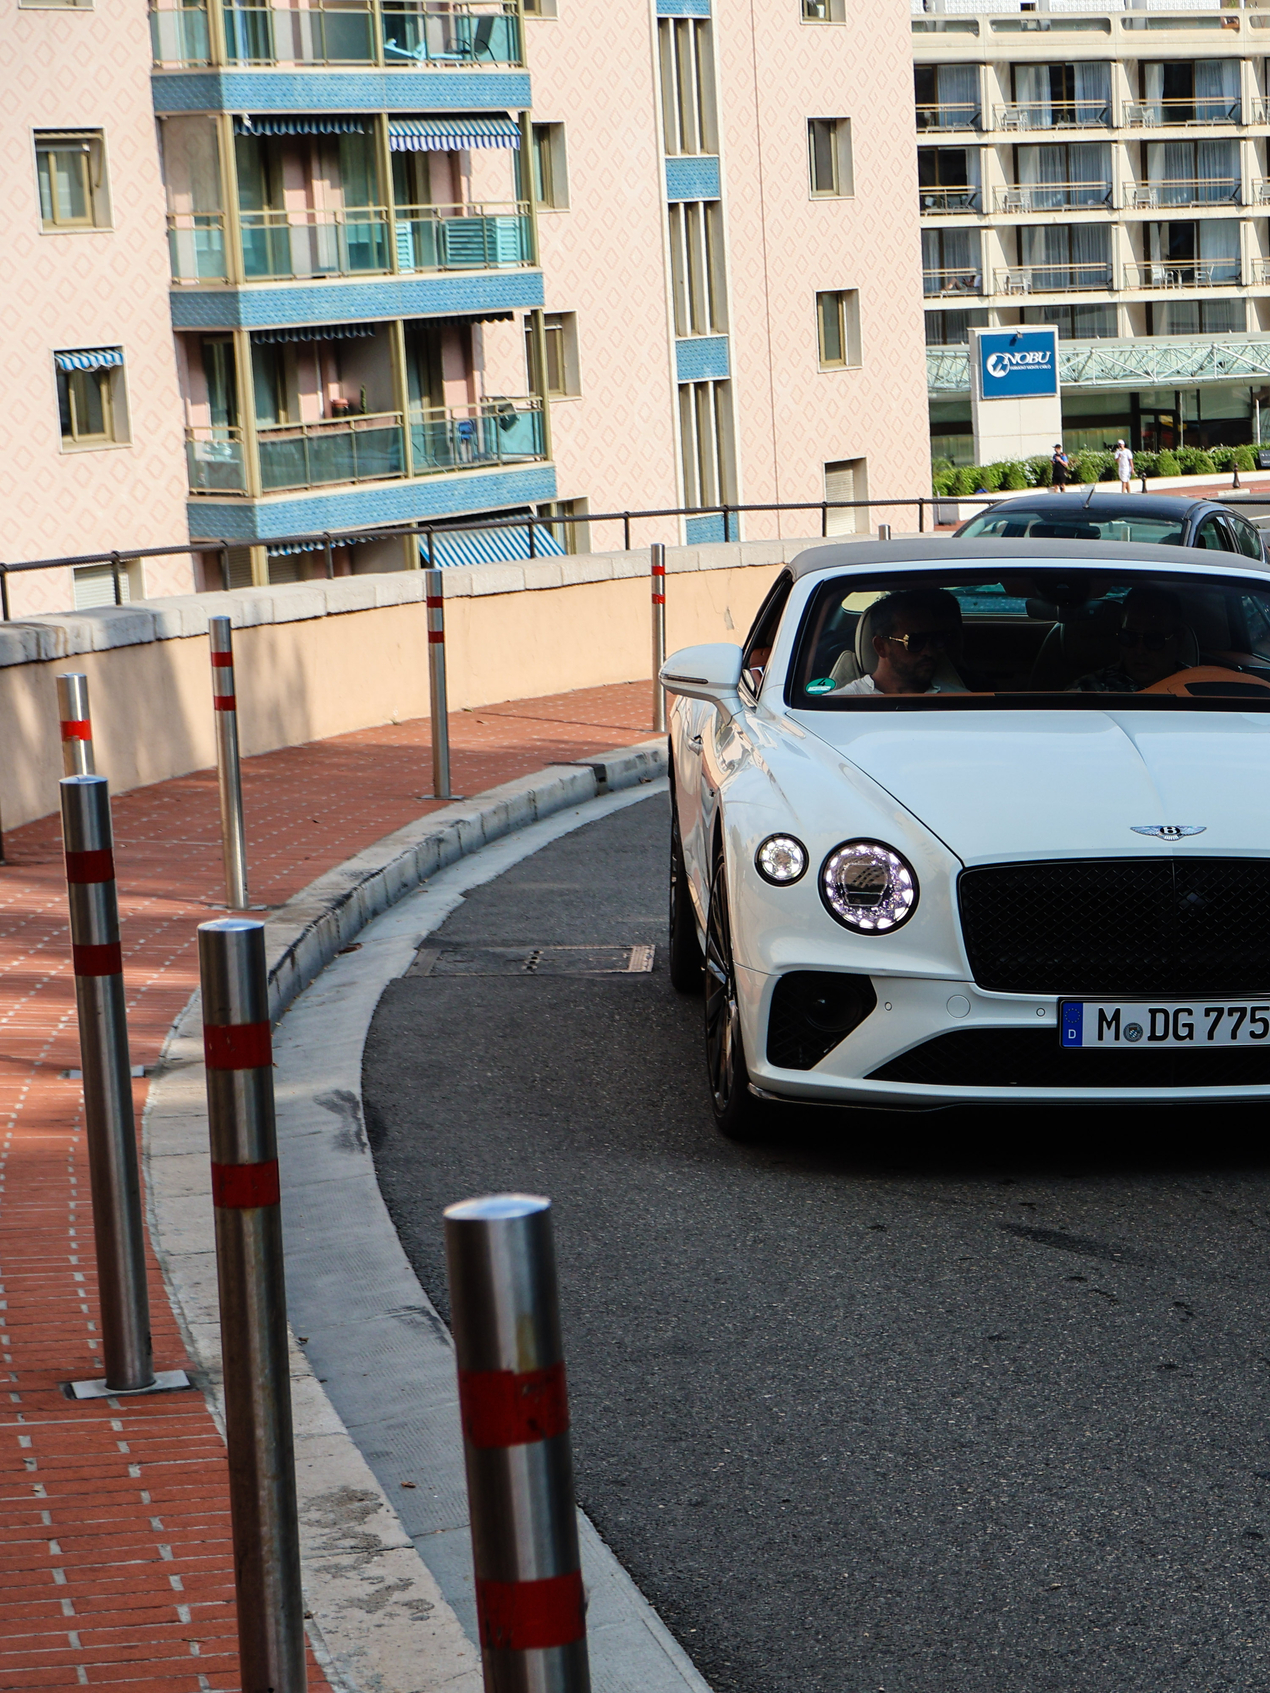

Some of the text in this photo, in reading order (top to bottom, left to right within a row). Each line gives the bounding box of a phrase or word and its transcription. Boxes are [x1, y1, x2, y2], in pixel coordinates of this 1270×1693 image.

[1002, 351, 1052, 365] NOBU
[1098, 1005, 1270, 1042] M DG 775
[1068, 1029, 1077, 1039] D
